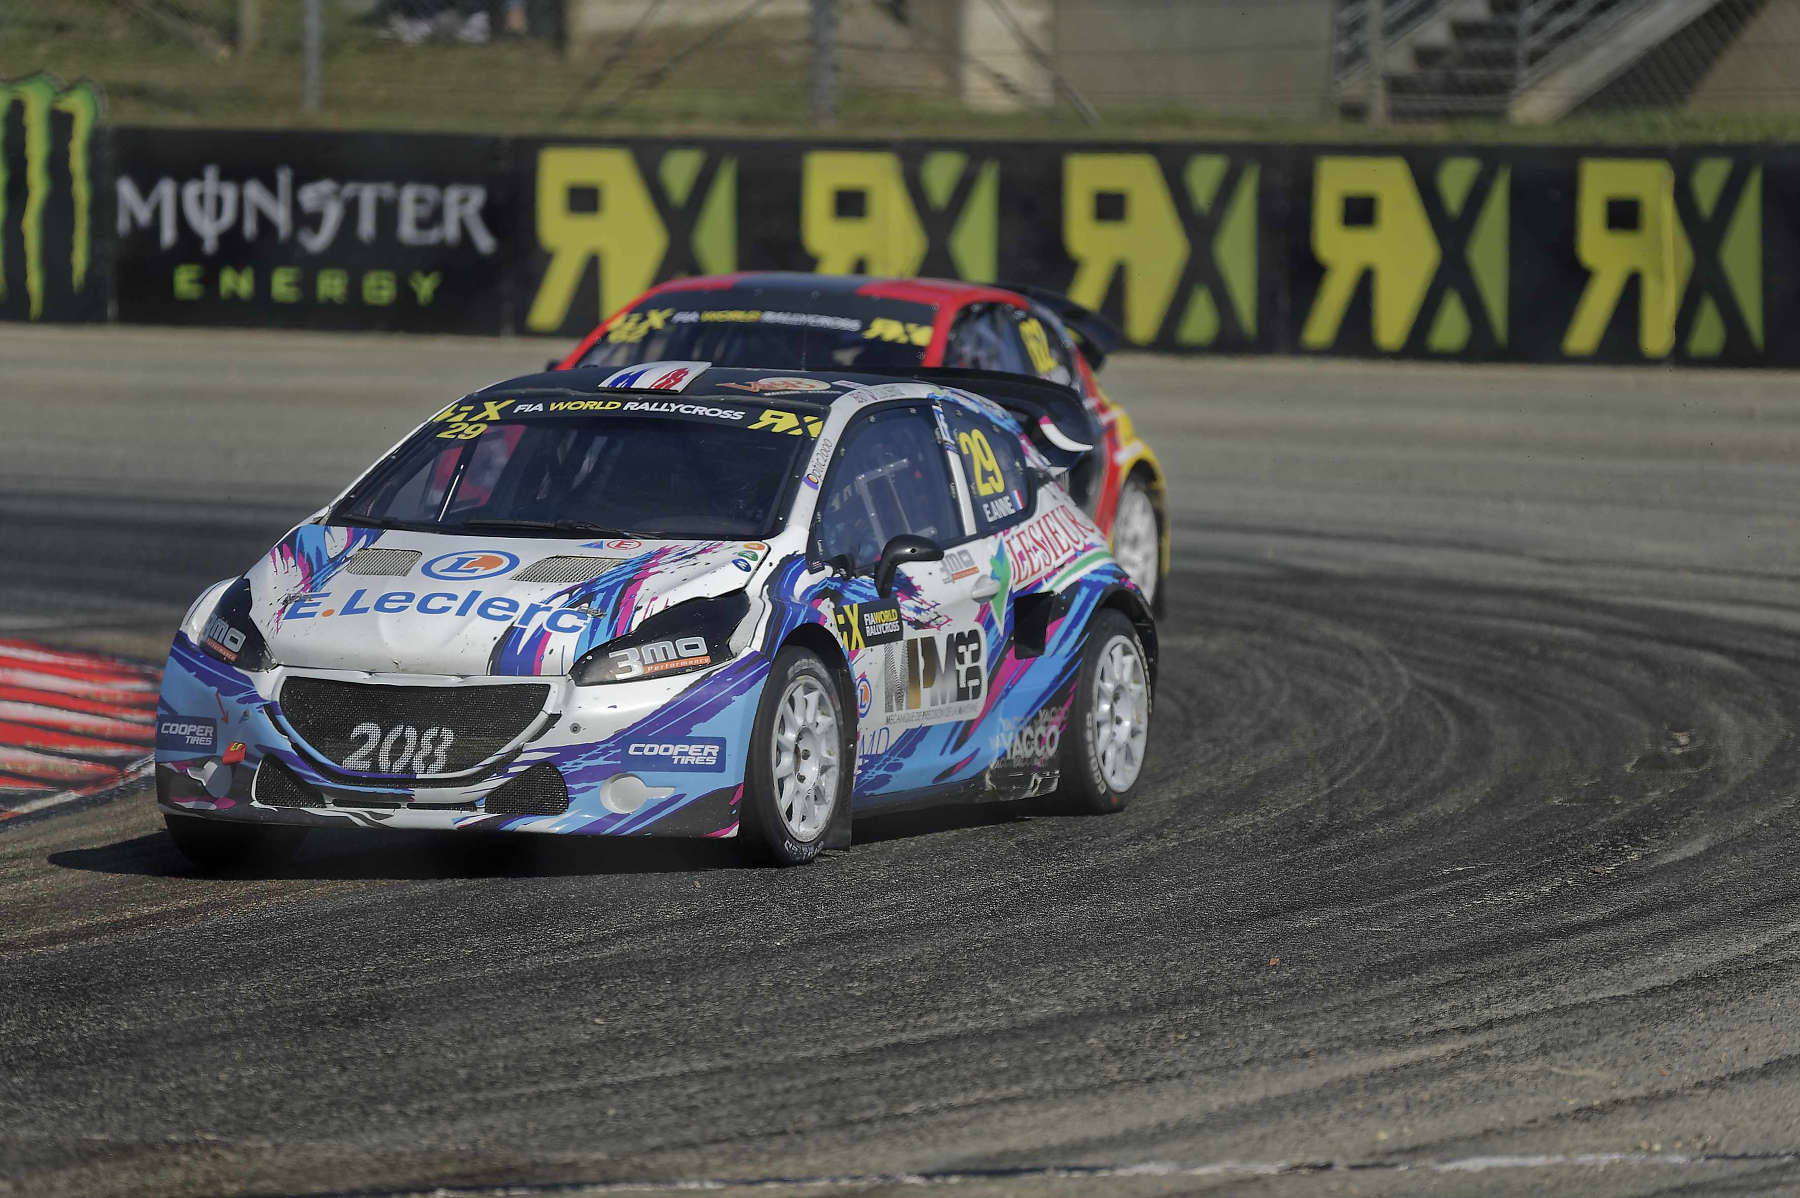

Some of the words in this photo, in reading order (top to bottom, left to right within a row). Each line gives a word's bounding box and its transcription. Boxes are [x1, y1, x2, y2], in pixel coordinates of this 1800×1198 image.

[115, 163, 496, 256] MONSTER
[173, 264, 443, 306] ENERGY
[513, 403, 544, 413] FIA
[549, 400, 622, 411] WORLD
[623, 402, 746, 420] RALLYCROSS
[436, 422, 488, 440] 29
[958, 429, 1005, 496] 29
[1006, 504, 1095, 585] LESIEUR
[282, 588, 589, 634] E.Leclerc
[865, 621, 900, 637] RALLYCROSS
[160, 722, 214, 737] COOPER
[185, 735, 213, 746] TIRES
[342, 722, 455, 775] 208
[628, 743, 720, 757] COOPER
[672, 755, 717, 766] TIRES
